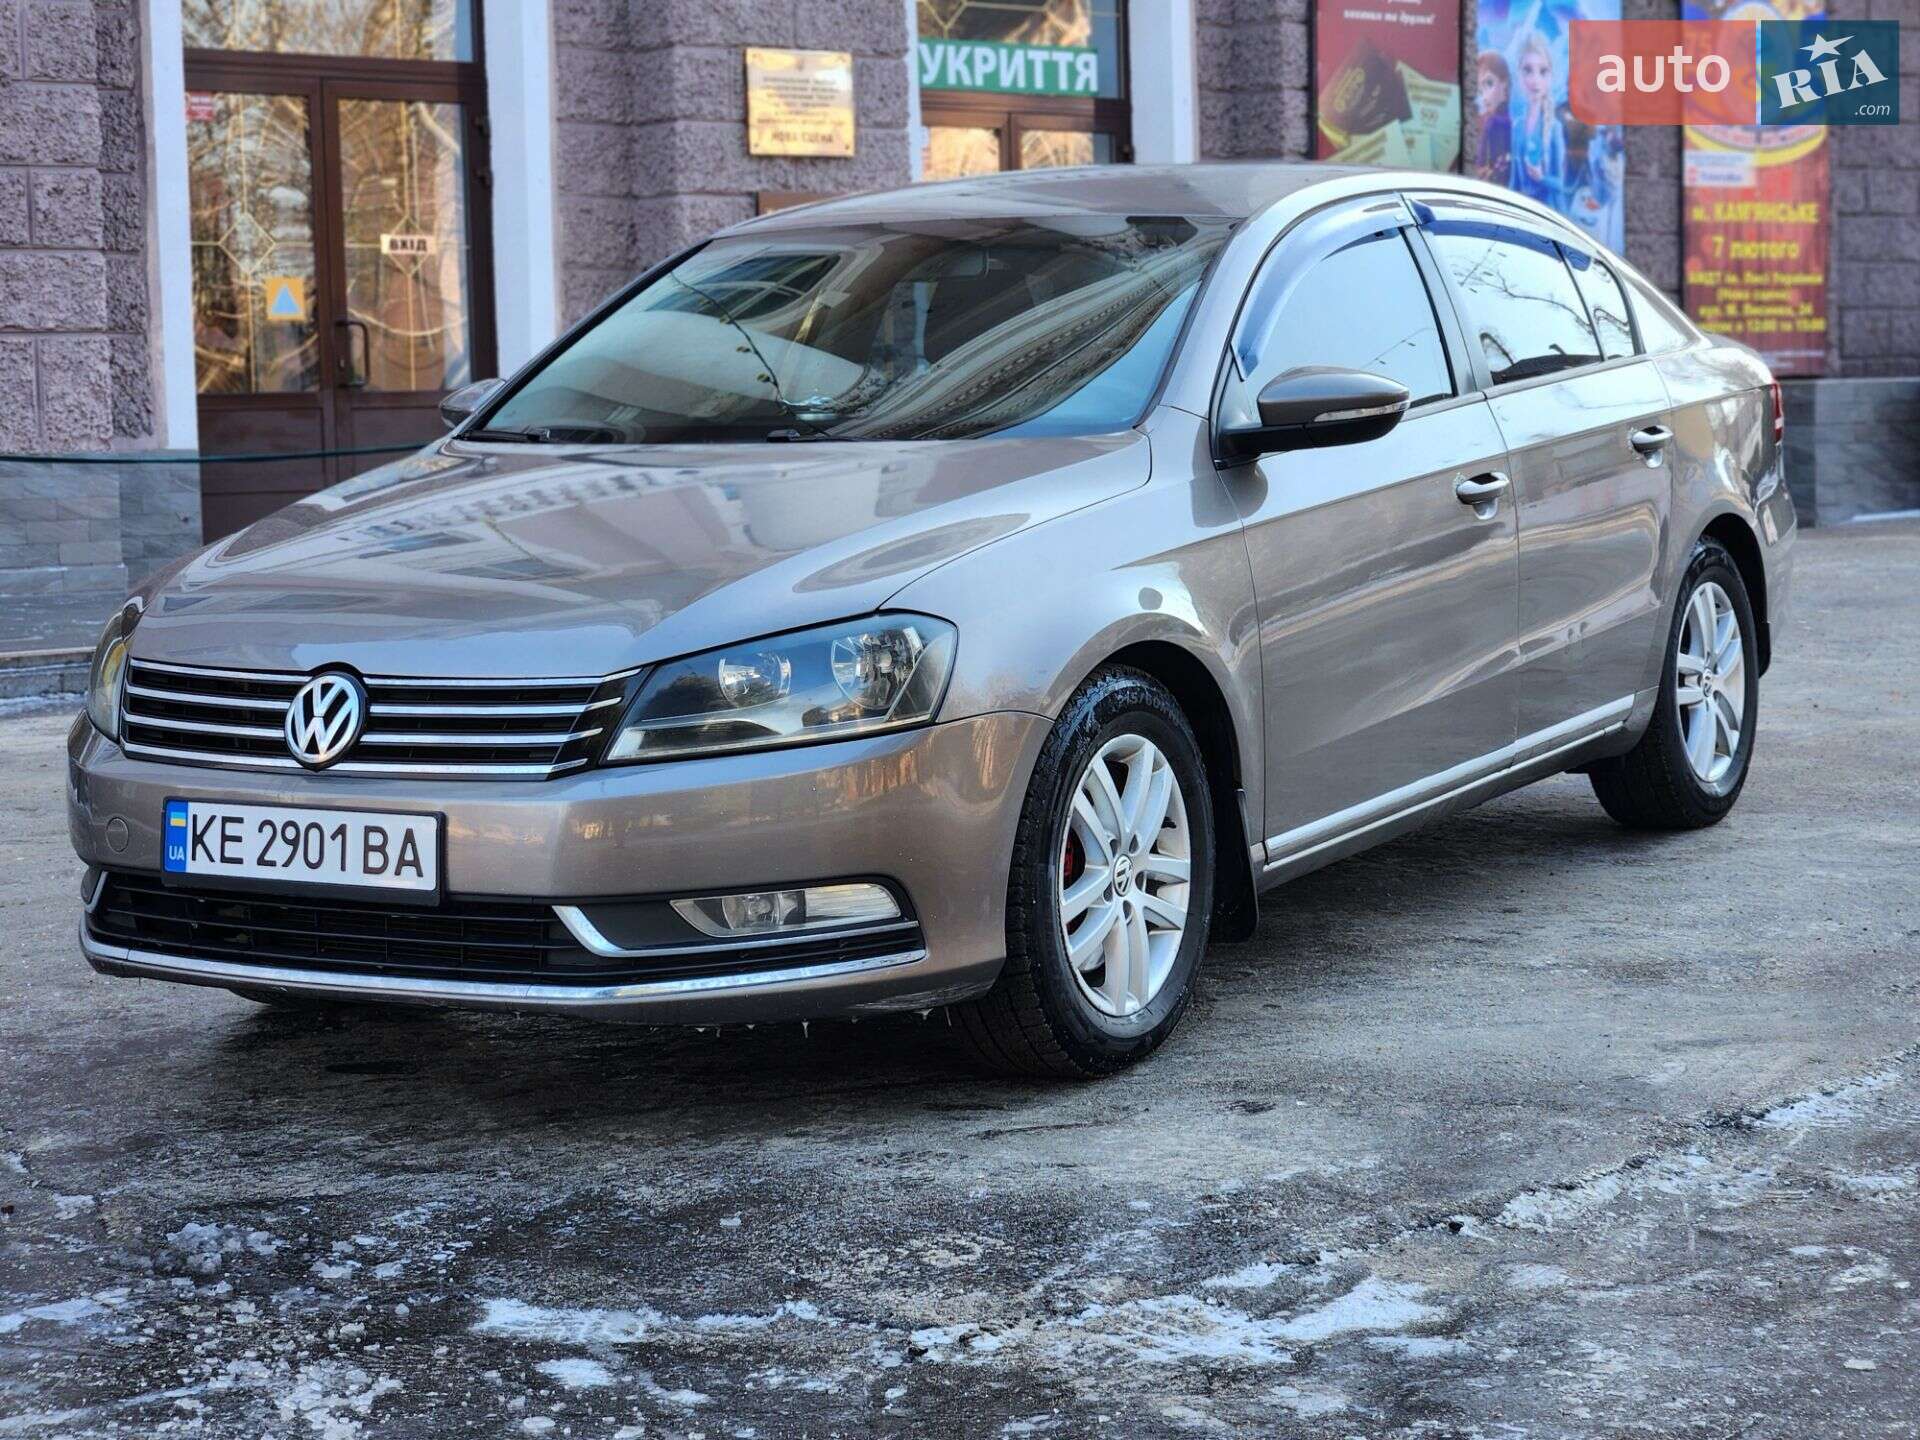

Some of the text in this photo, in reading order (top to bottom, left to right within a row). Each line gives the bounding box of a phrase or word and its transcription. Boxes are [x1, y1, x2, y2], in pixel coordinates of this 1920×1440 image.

[918, 43, 1099, 92] УКРИТТЯ
[389, 238, 428, 251] ВХІД
[1712, 235, 1724, 258] 7
[168, 845, 185, 861] UA
[191, 814, 424, 878] KE 2901 BA
